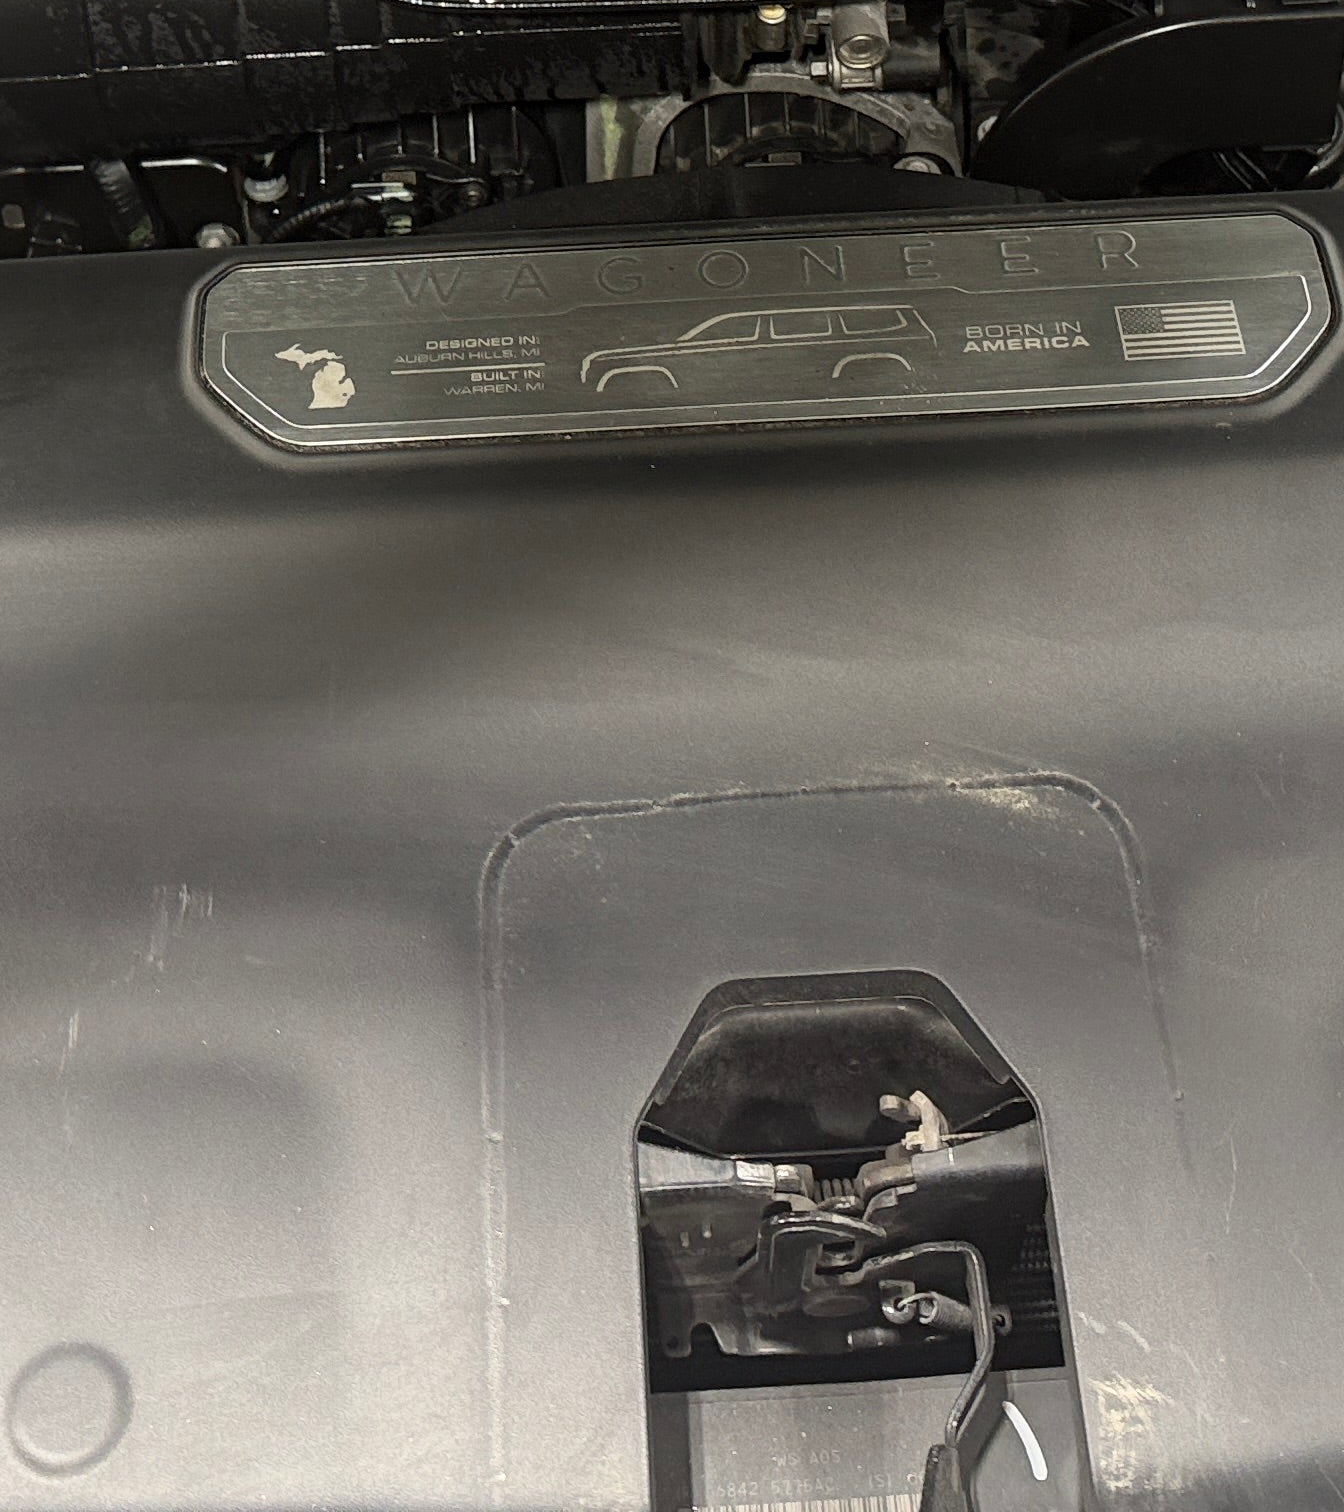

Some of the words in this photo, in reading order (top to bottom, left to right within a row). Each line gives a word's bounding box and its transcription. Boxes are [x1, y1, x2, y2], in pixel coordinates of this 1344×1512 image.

[394, 230, 1140, 305] WAGONEER
[965, 323, 1044, 339] BORN
[1055, 321, 1082, 335] IN
[425, 336, 514, 350] DESIGNED
[963, 335, 1091, 353] AMERICA
[394, 351, 465, 364] AUBURN
[521, 347, 540, 358] MI
[470, 370, 520, 382] BUILT
[525, 381, 545, 392] MI
